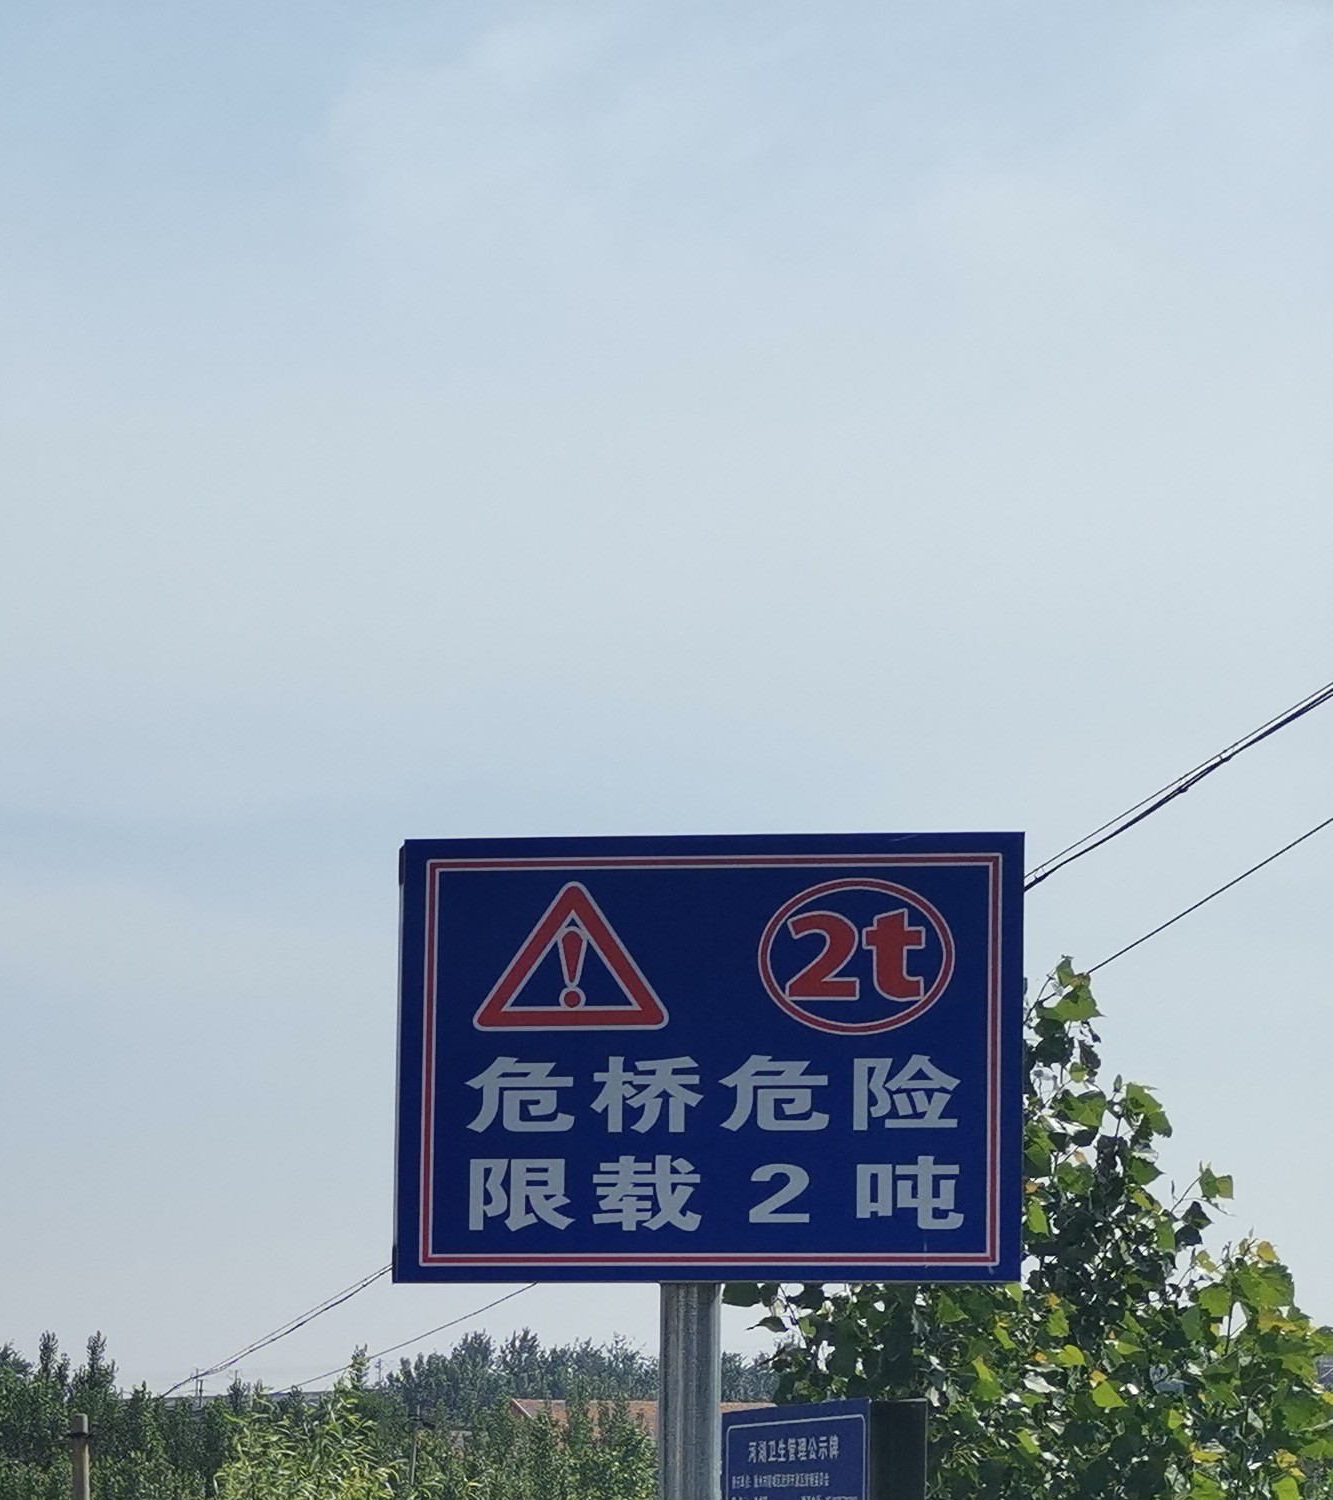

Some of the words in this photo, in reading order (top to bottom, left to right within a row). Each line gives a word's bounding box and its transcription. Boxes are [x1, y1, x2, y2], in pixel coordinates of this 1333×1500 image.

[786, 908, 927, 1001] 2t
[464, 1053, 963, 1134] 危桥危险
[467, 1154, 965, 1232] 限载2吨
